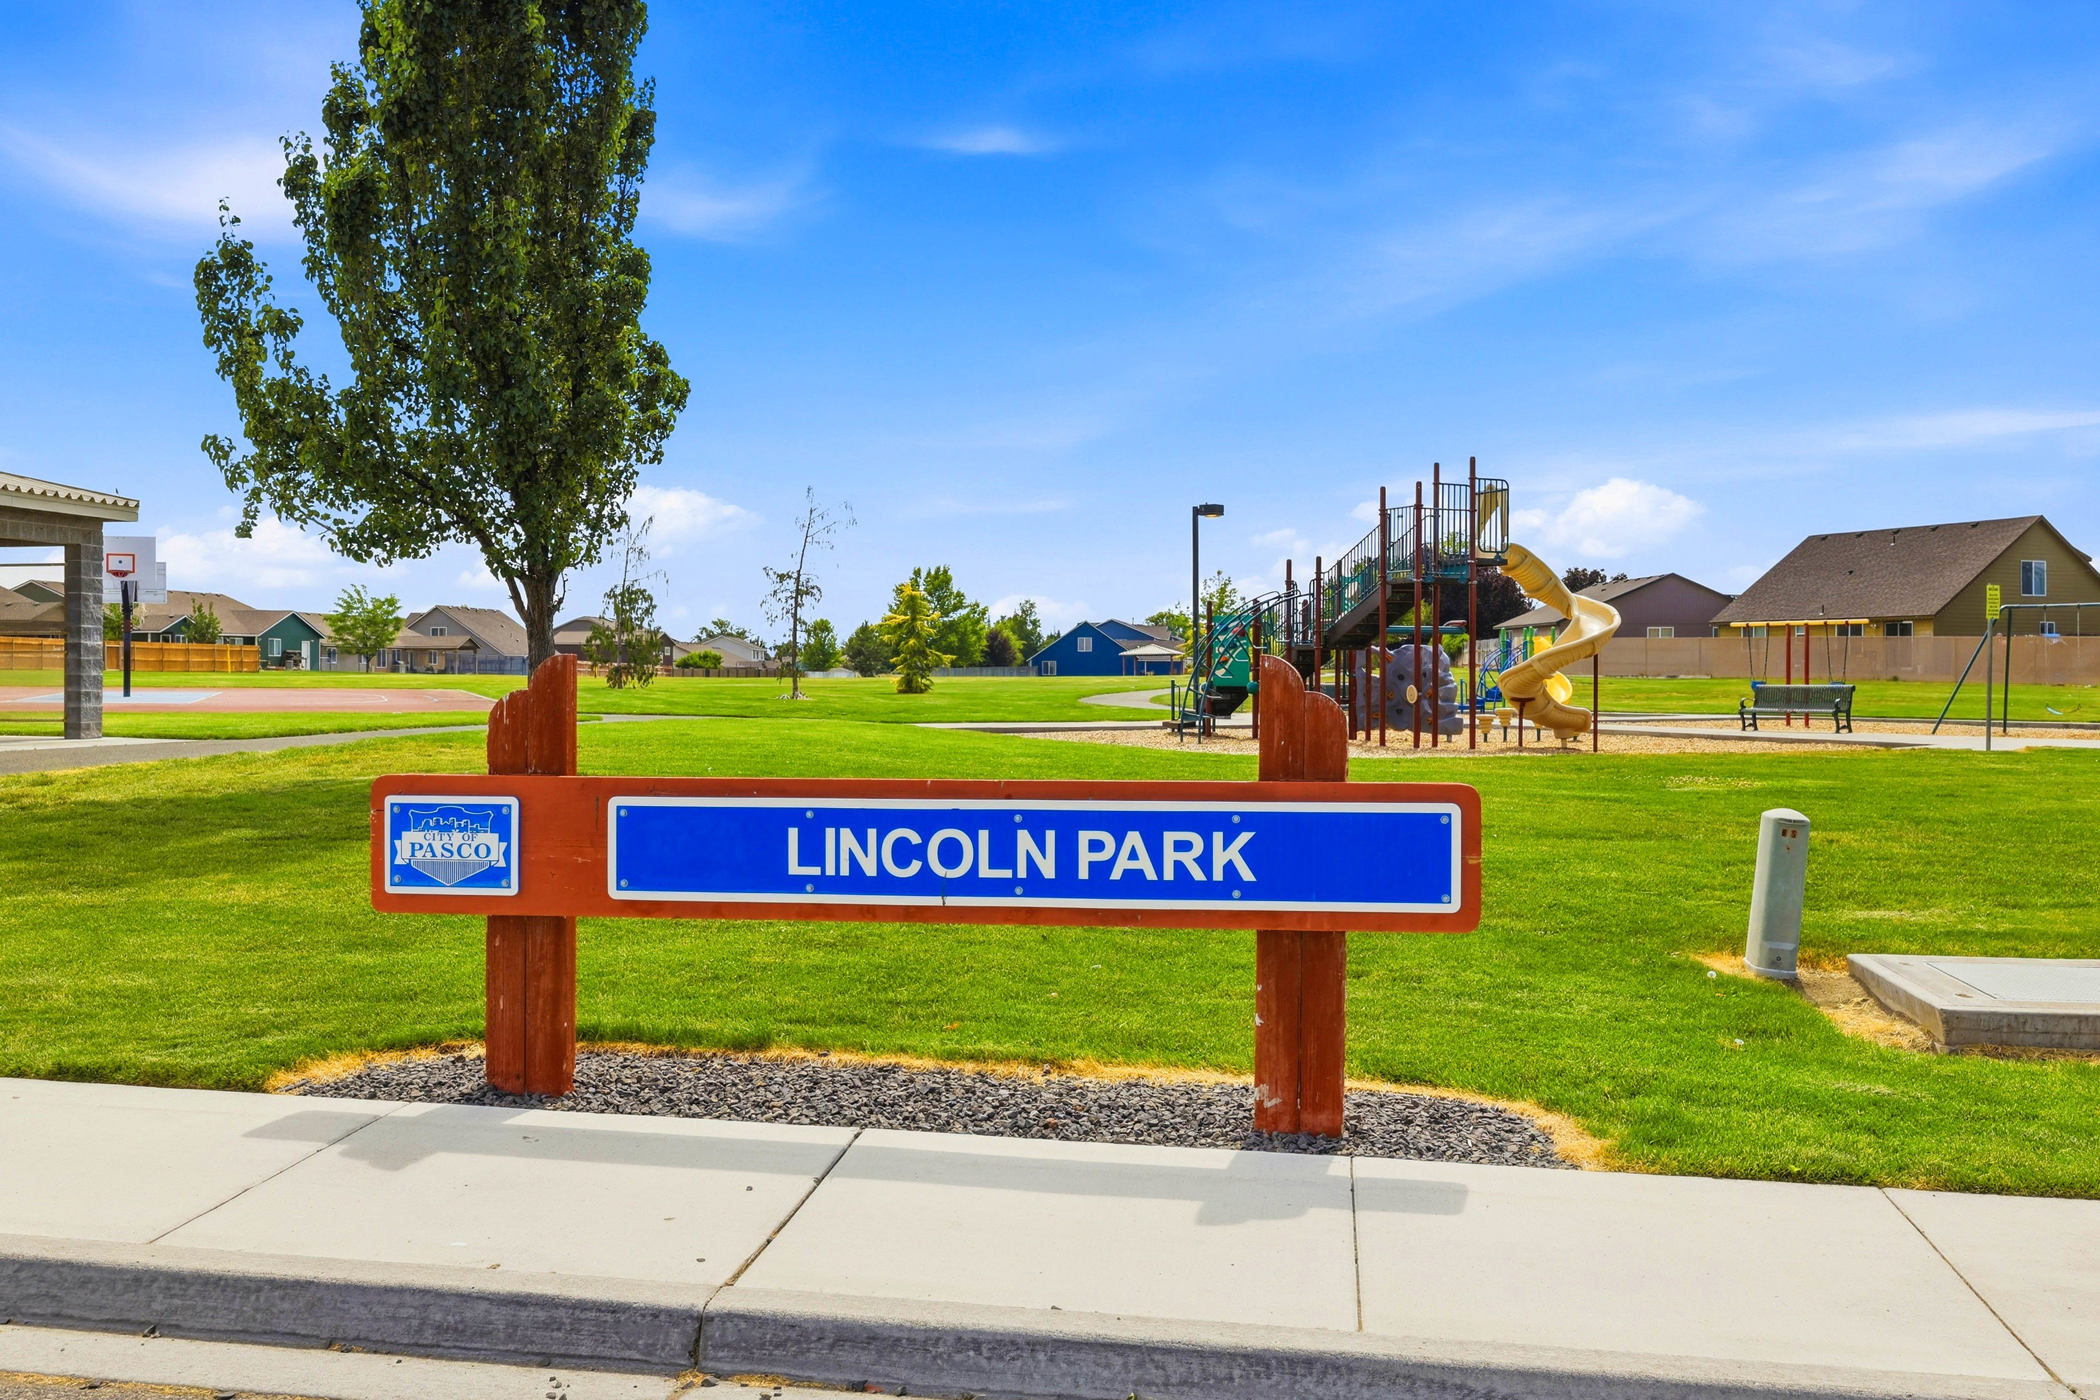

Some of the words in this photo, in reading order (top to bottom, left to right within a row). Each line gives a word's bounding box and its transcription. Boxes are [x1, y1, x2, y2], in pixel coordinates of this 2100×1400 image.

[423, 832, 454, 842] CITY
[461, 833, 478, 842] OF
[409, 842, 492, 859] PASCO
[787, 827, 1056, 878] LINCOLN
[1078, 831, 1257, 882] PARK
